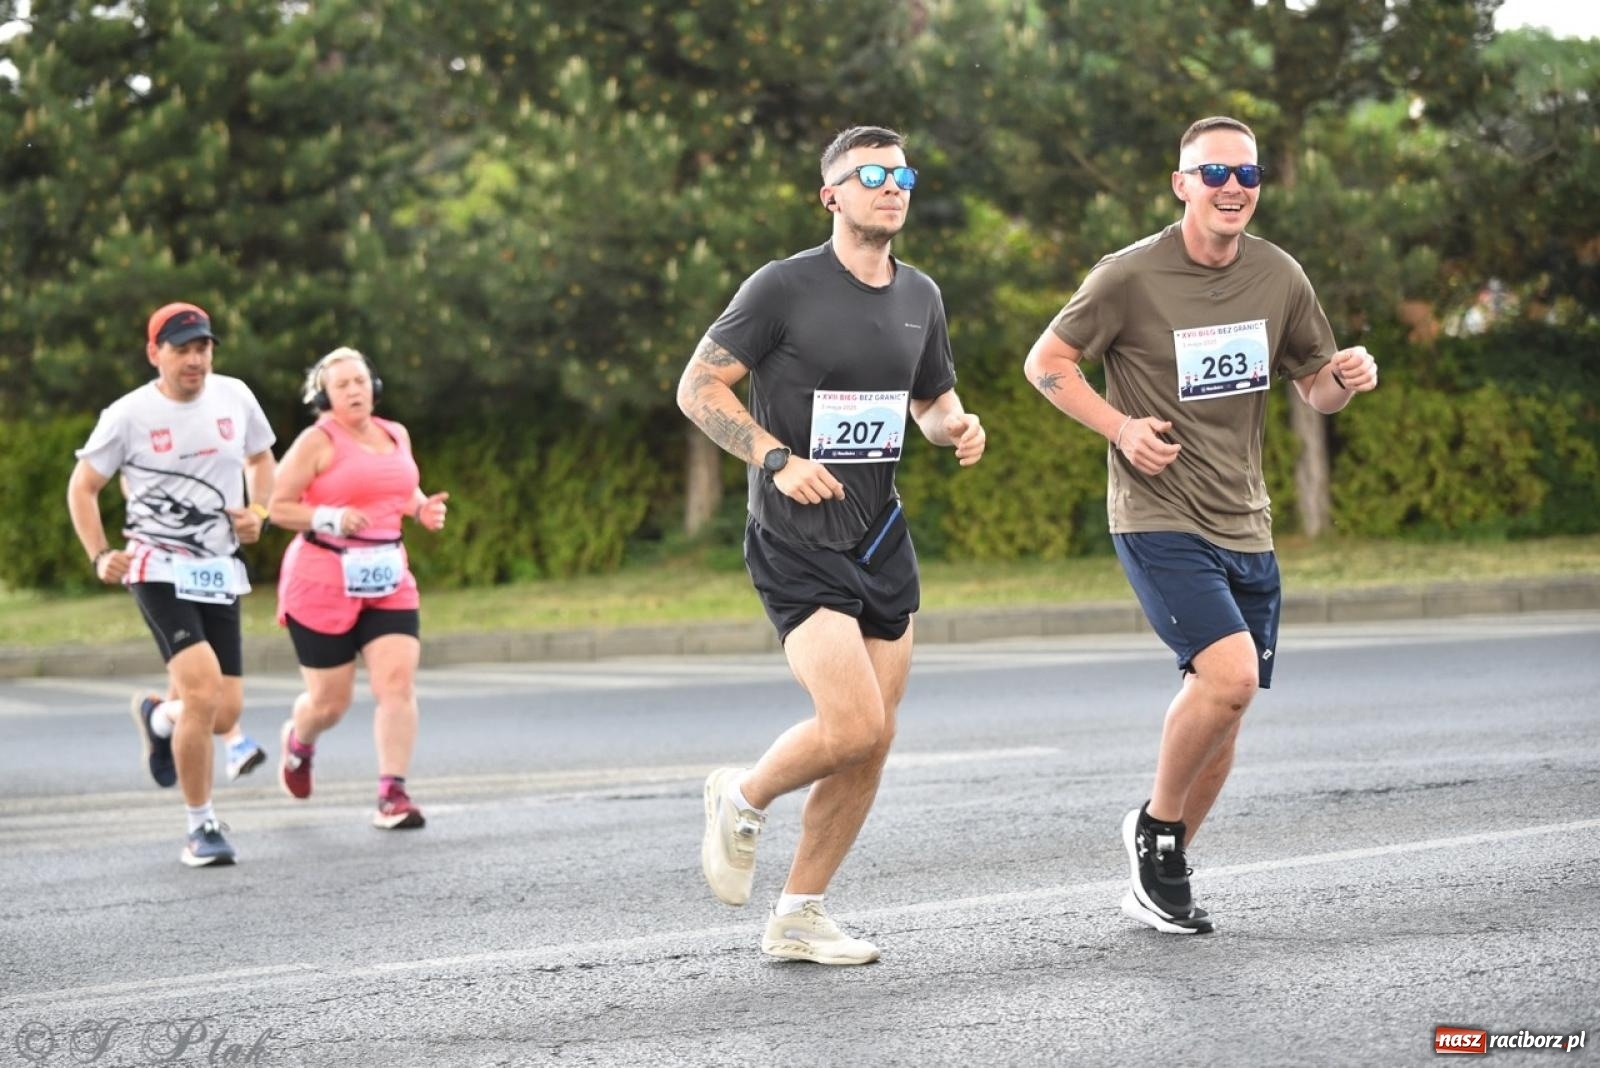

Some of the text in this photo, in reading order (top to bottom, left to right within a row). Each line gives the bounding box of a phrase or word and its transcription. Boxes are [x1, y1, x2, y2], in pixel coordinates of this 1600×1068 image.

[1198, 329, 1216, 337] BIEG
[1217, 327, 1232, 335] BEZ
[1233, 323, 1260, 332] GRANIC
[1201, 352, 1248, 380] 263
[839, 393, 857, 401] BIEG
[874, 393, 902, 401] GRANIC
[835, 421, 885, 445] 207
[190, 570, 225, 588] 198
[360, 566, 394, 583] 260
